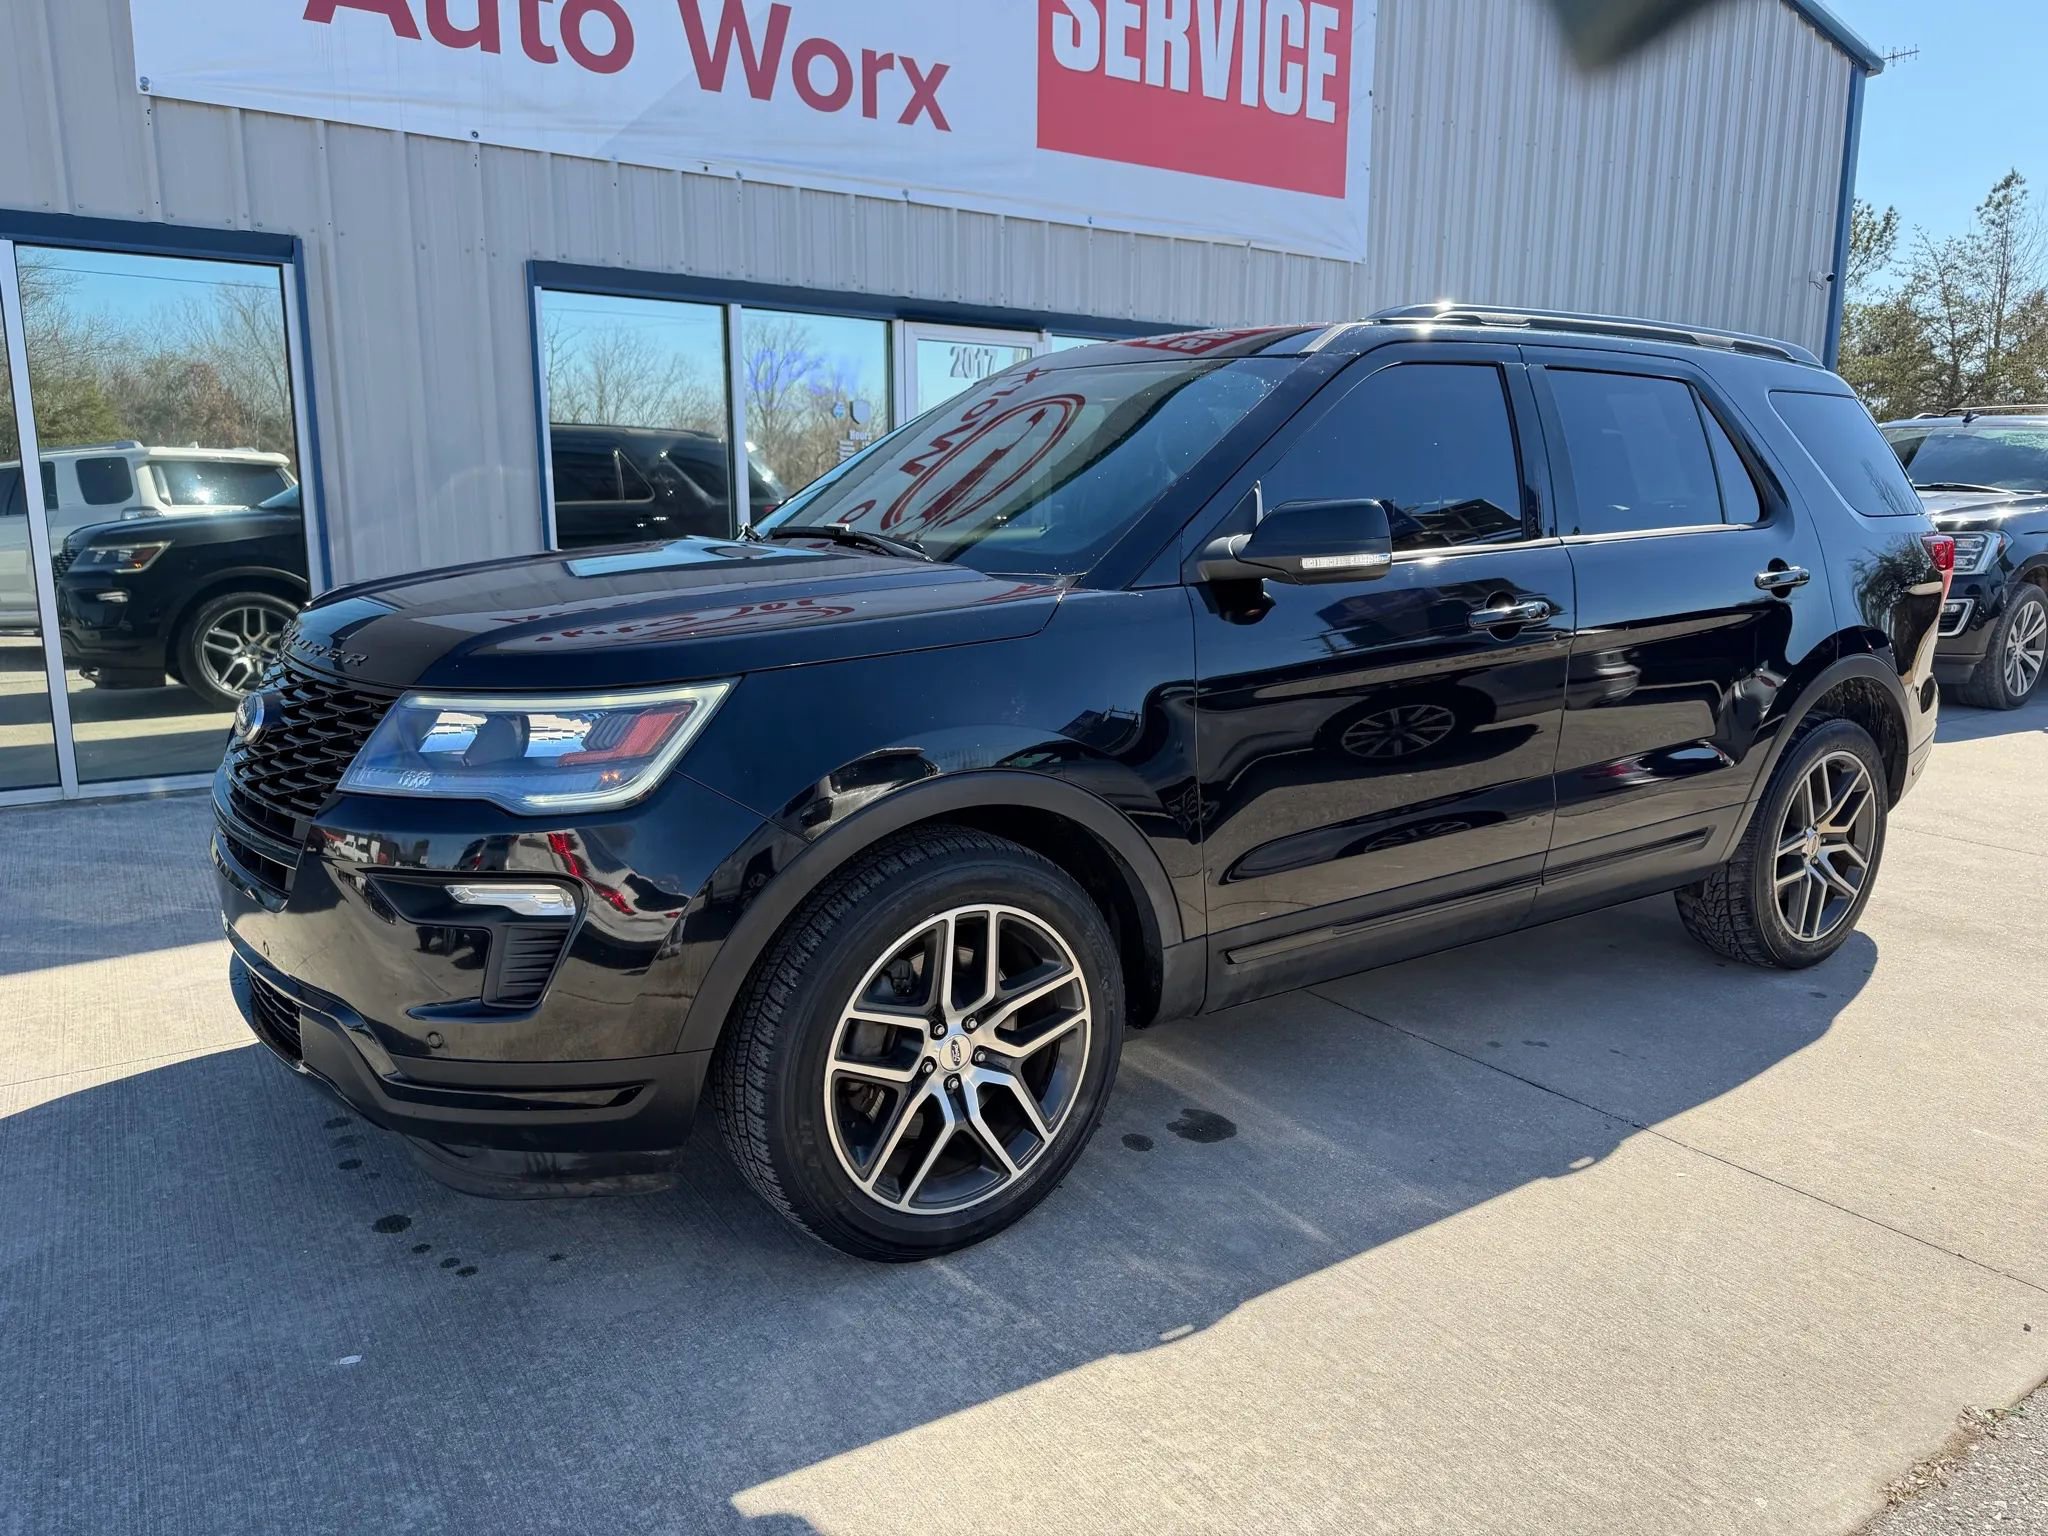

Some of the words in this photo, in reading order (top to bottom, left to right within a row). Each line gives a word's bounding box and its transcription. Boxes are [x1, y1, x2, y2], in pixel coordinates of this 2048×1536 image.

[676, 0, 952, 132] Worx
[1051, 0, 1340, 124] SERVICE
[949, 346, 998, 379] 2017
